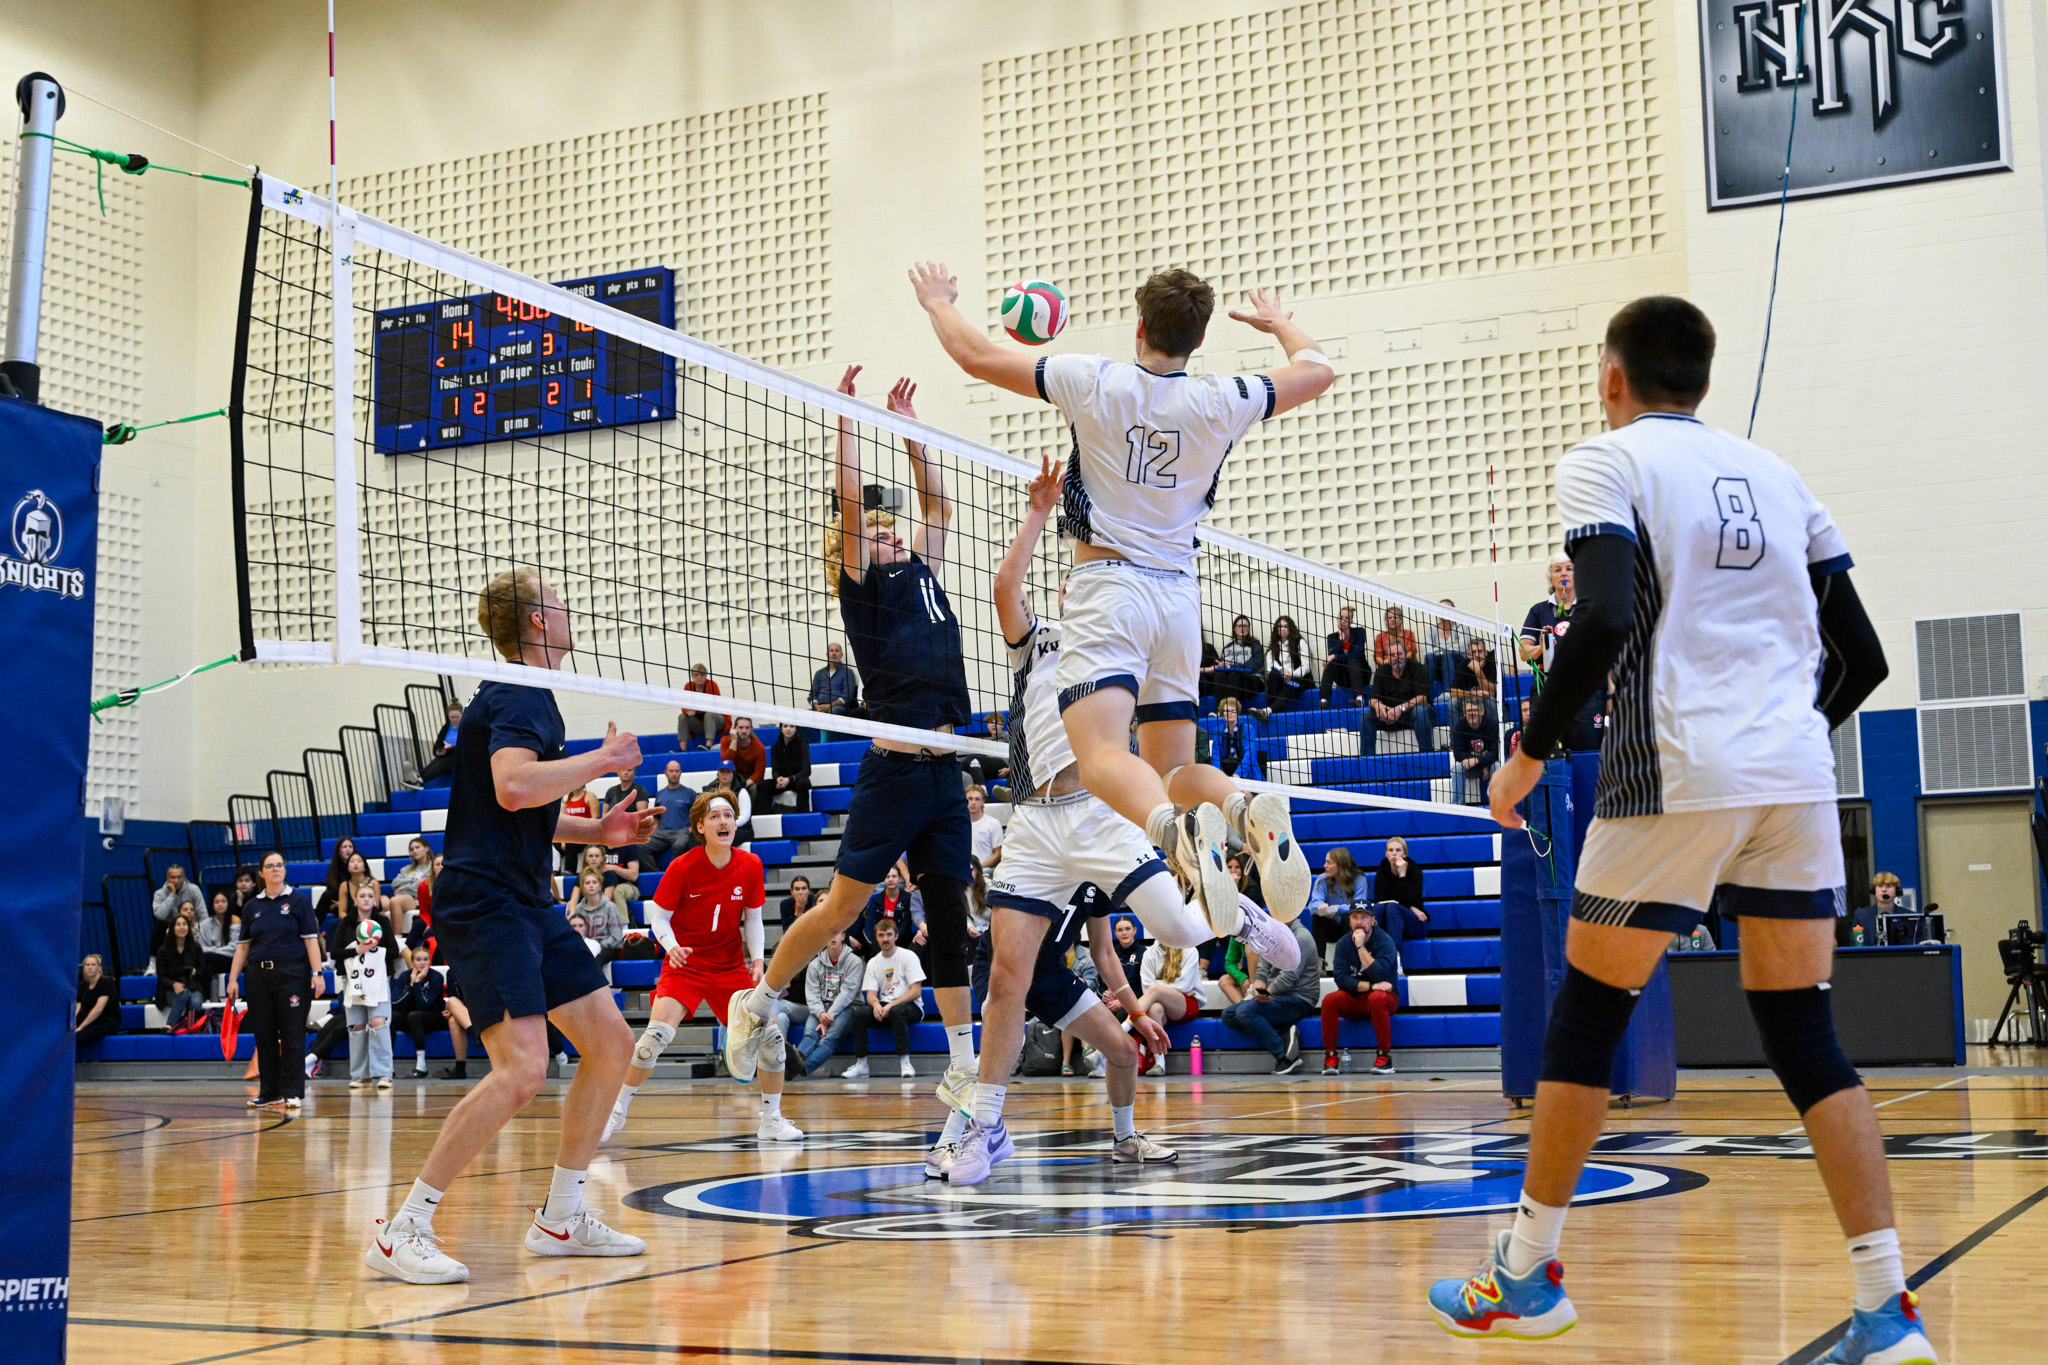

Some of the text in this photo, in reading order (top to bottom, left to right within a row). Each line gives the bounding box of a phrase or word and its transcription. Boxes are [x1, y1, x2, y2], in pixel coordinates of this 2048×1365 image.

[1734, 0, 1966, 132] NKC
[626, 281, 639, 292] pts
[645, 278, 656, 288] fls
[442, 304, 469, 318] Home
[398, 316, 410, 327] ps
[453, 320, 473, 350] 14
[543, 333, 554, 356] 3
[500, 340, 532, 361] period
[571, 356, 595, 372] fouls
[440, 375, 463, 390] fouls
[501, 366, 533, 383] player
[547, 381, 559, 405] 2
[586, 378, 591, 398] 1
[454, 396, 459, 416] 1
[473, 391, 485, 415] 2
[573, 409, 594, 421] won
[442, 426, 461, 438] won
[504, 418, 529, 433] game
[1126, 425, 1180, 489] 12
[1712, 476, 1766, 570] 8
[920, 577, 946, 624] 11
[711, 904, 721, 932] 1
[1055, 904, 1078, 943] 7
[0, 1302, 65, 1313] MERICA
